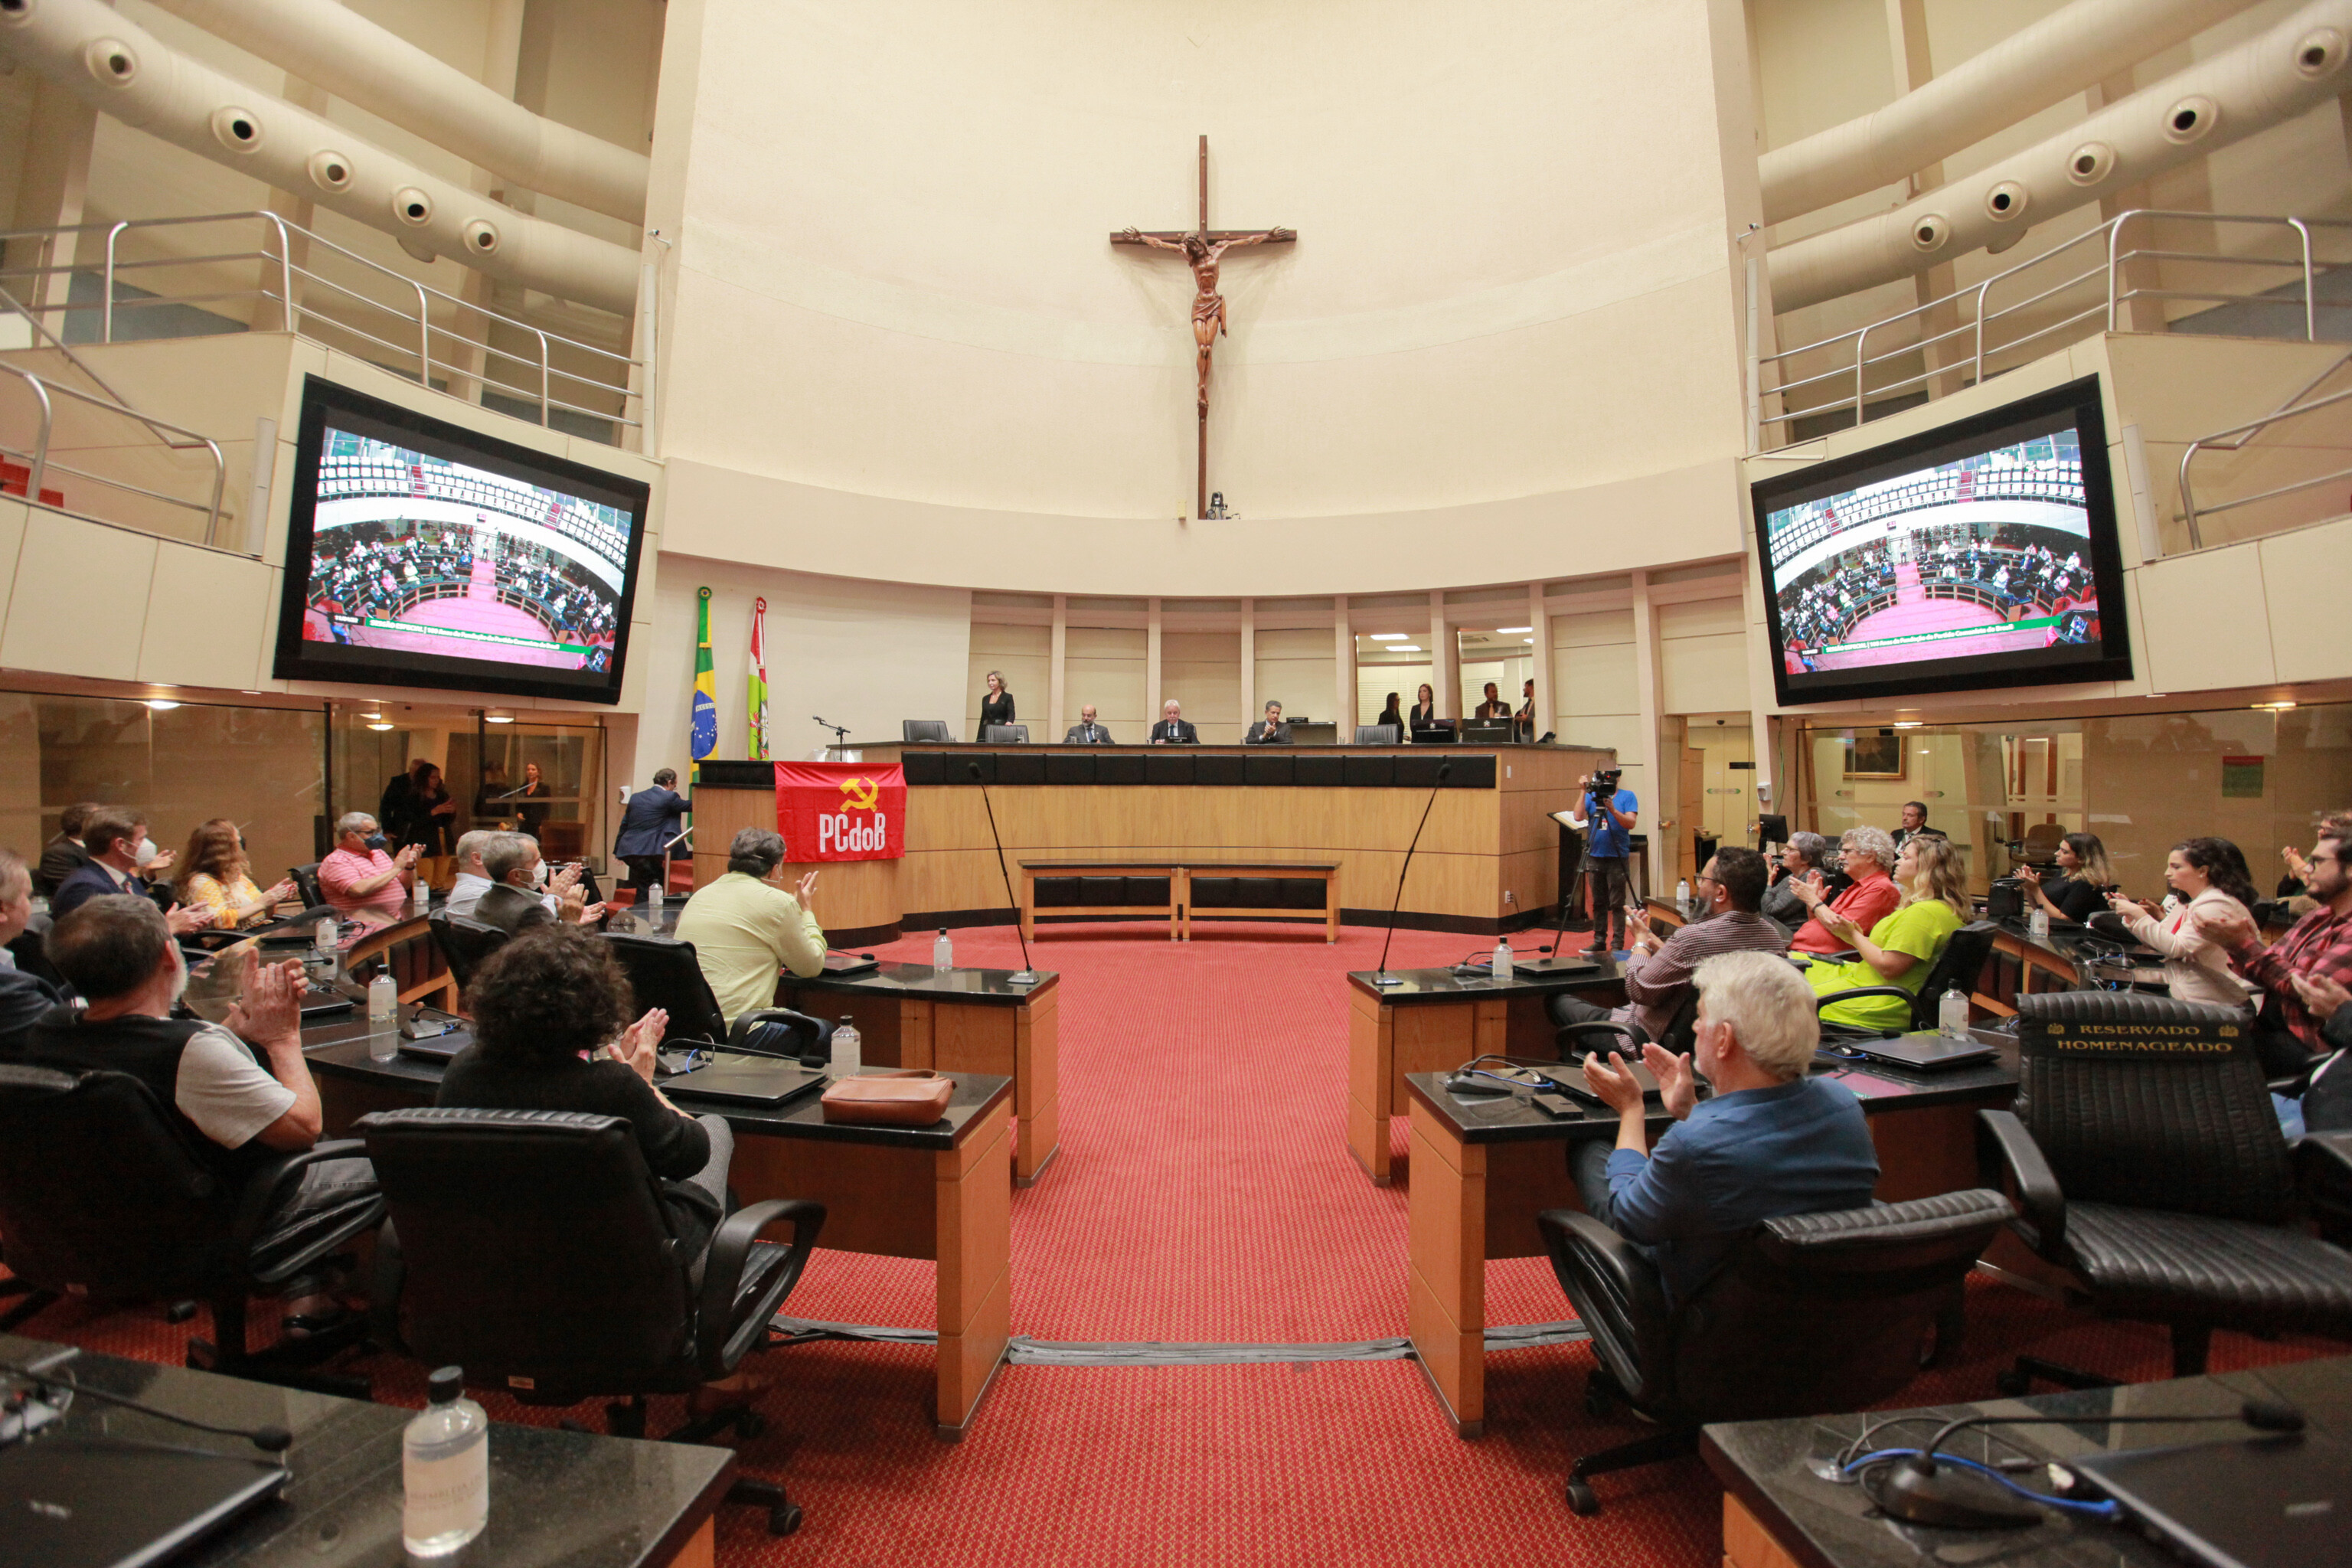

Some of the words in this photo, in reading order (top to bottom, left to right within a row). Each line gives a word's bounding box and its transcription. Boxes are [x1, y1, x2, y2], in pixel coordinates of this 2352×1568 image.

[819, 812, 887, 854] PCdoB
[2079, 1024, 2200, 1035] RESERVADO
[2057, 1040, 2233, 1053] HOMENAGEADO
